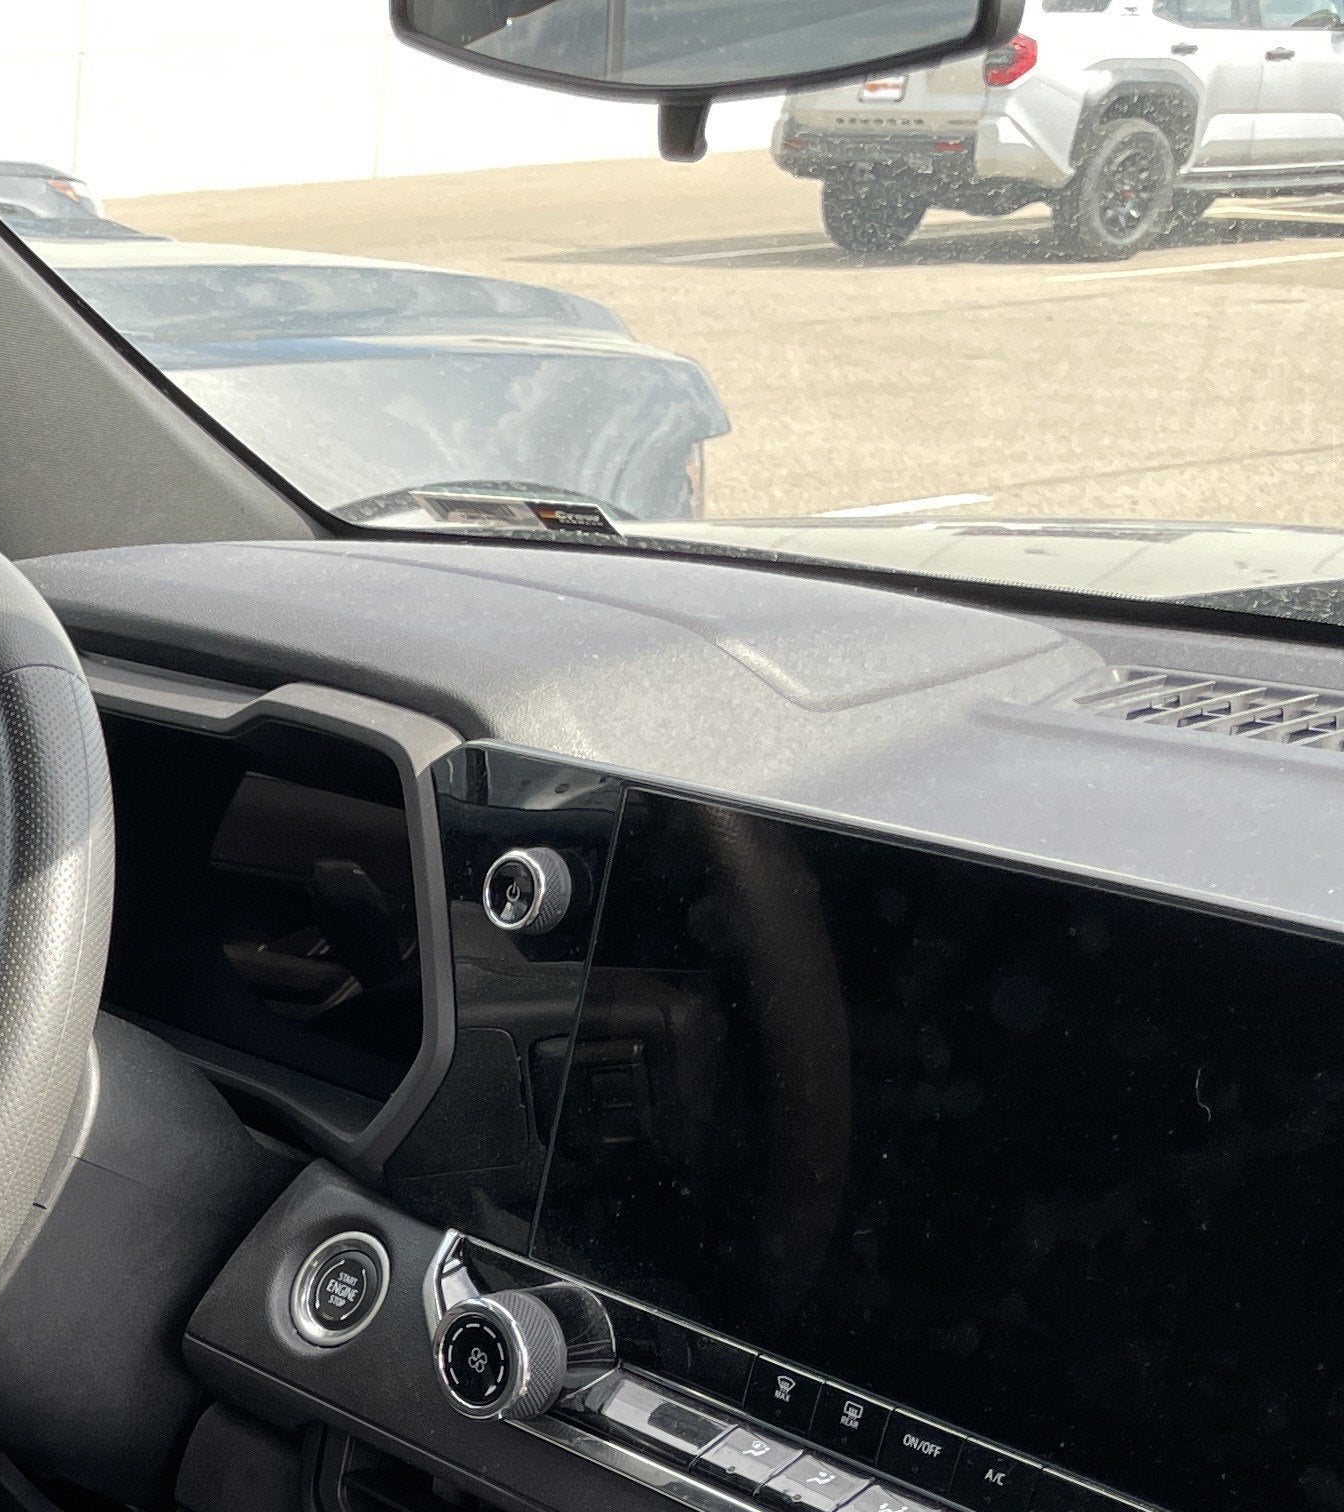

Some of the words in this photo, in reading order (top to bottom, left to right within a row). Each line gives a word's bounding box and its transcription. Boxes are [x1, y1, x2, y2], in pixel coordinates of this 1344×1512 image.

[337, 1272, 358, 1287] START
[326, 1279, 359, 1302] ENGINE
[327, 1294, 346, 1307] STOP
[774, 1389, 791, 1402] MAX
[839, 1415, 860, 1430] REAR
[902, 1432, 944, 1458] ON/OFF
[983, 1468, 1007, 1487] A/C
